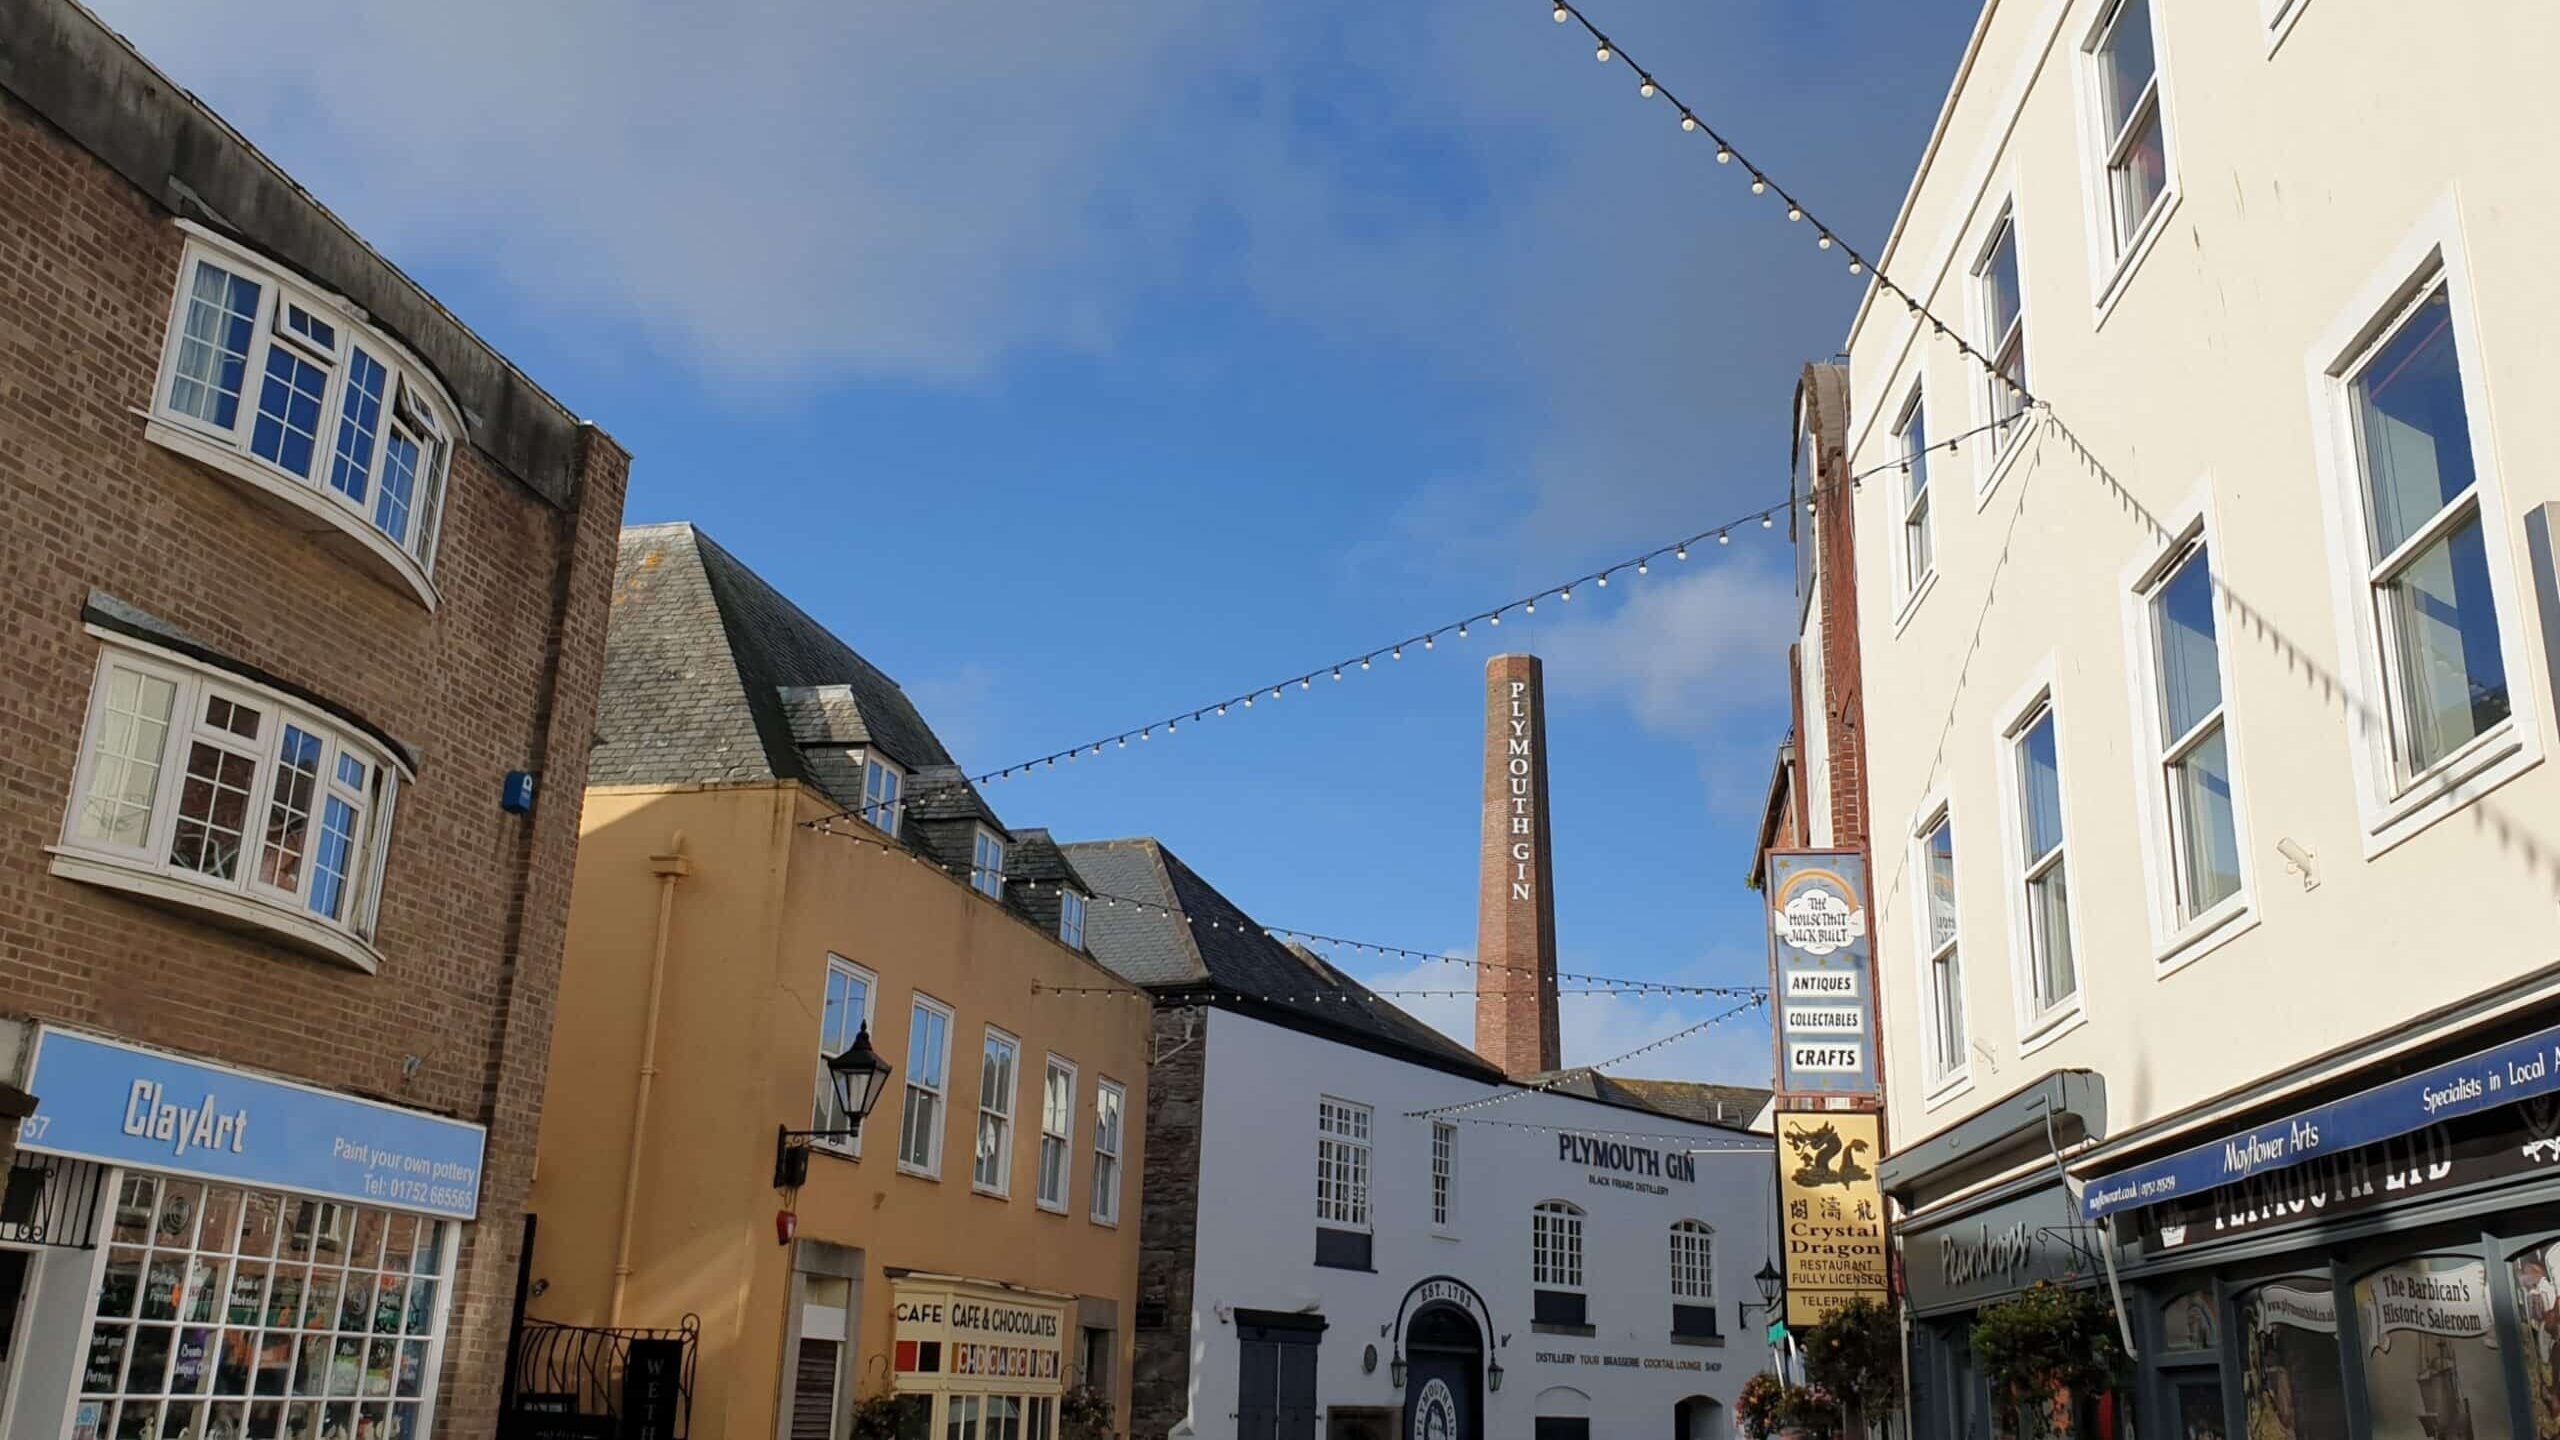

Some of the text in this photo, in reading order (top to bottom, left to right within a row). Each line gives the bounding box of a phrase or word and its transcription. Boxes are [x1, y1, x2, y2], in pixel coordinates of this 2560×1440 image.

[1509, 681, 1530, 901] PLYMOUTH GIN
[1808, 897, 1827, 910] THE
[1792, 976, 1851, 992] ANTIQUES
[1790, 1012, 1858, 1028] COLLECTABLES
[1795, 1049, 1856, 1067] CRAFTS
[2423, 1077, 2482, 1115] Specialists
[2488, 1070, 2501, 1092] in
[2508, 1052, 2545, 1086] Local
[122, 1077, 248, 1156] ClayArt
[1558, 1132, 1696, 1184] PLYMOUTH GIN
[2223, 1120, 2319, 1175] Mayflower Arts
[2383, 1122, 2451, 1191] LTD
[334, 1136, 476, 1187] Paint your own pottery
[364, 1173, 387, 1198] Tel:
[390, 1178, 428, 1203] 01752
[1790, 1224, 1879, 1241] Crystal
[1790, 1240, 1881, 1259] Dragon
[1940, 1220, 2031, 1287] Peardrops
[1800, 1259, 1873, 1272] RESTAURANT
[1792, 1272, 1883, 1286] FULLY LICENSED
[2382, 1274, 2471, 1302] The Barbican's
[1422, 1283, 1445, 1302] EST.
[1800, 1296, 1873, 1309] TELEPHOE
[896, 1303, 943, 1324] CAFE
[952, 1303, 1057, 1338] CAFE & CHOCOLATES
[2383, 1303, 2482, 1331] Historic Saleroom
[1536, 1352, 1575, 1365] DISTILLERY
